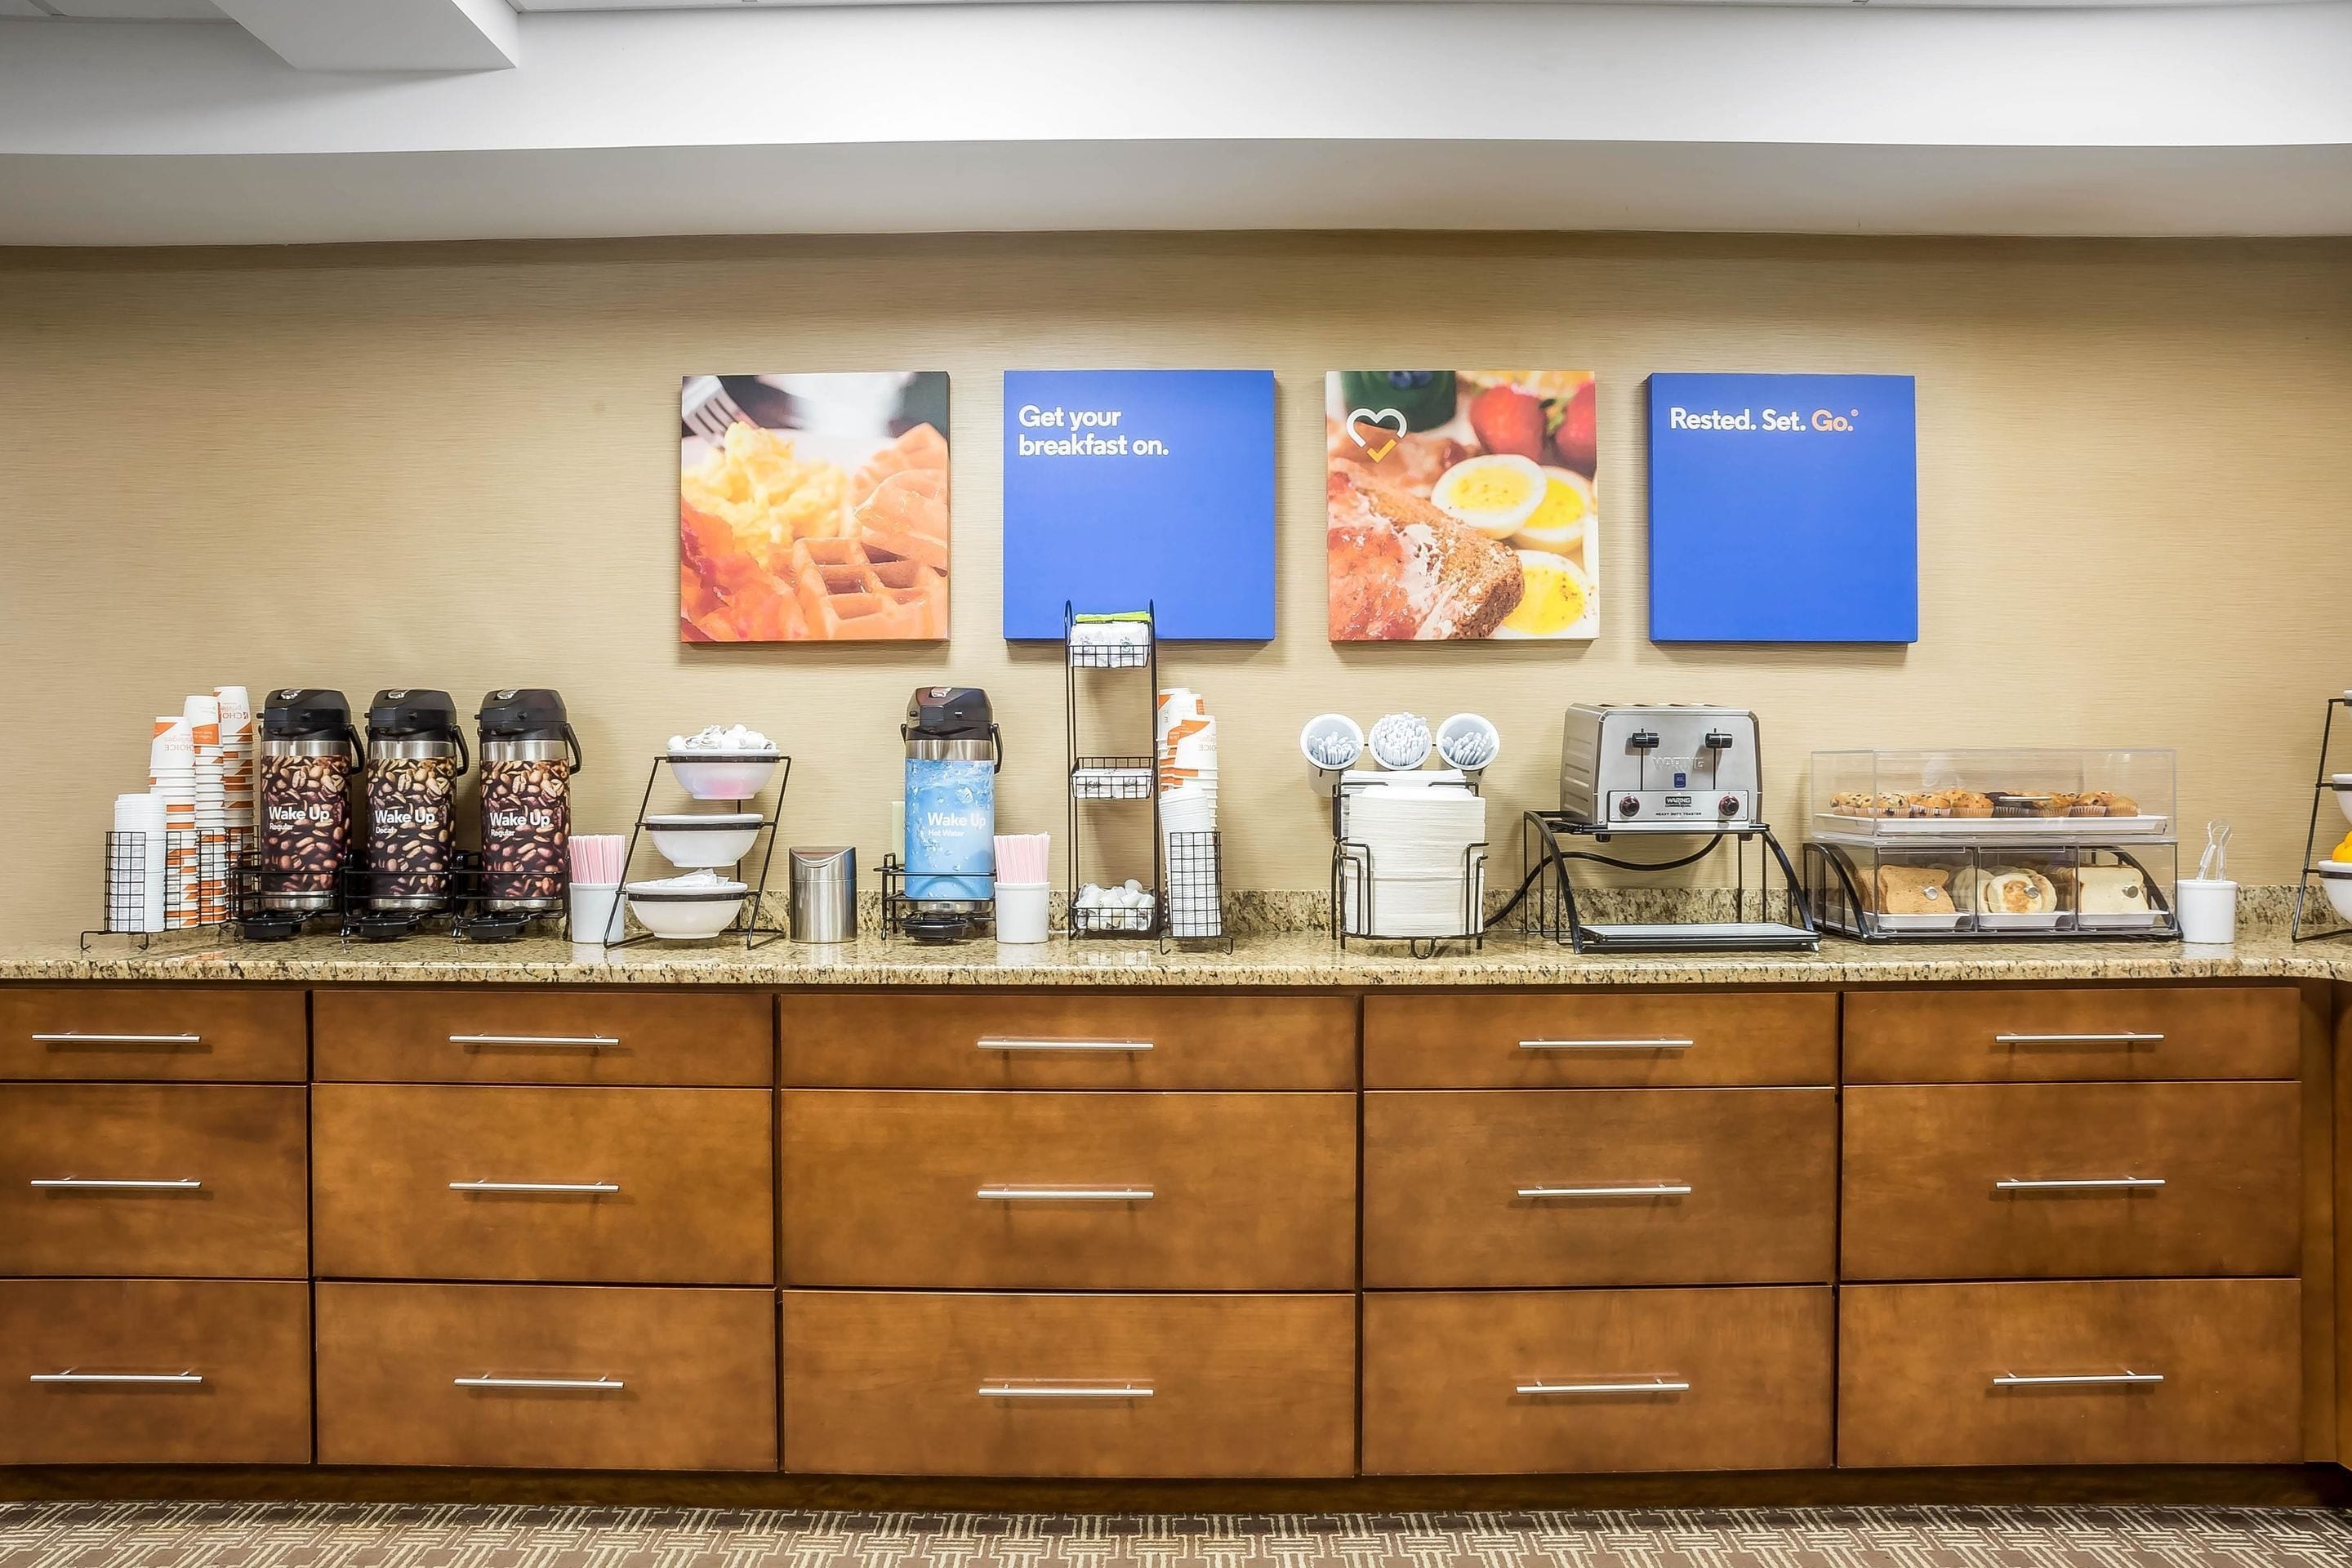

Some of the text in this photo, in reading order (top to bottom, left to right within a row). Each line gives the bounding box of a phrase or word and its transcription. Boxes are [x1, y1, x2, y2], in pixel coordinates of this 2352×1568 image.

[1018, 404, 1122, 432] Get your
[1670, 408, 1757, 431] Rested.
[1762, 408, 1806, 432] Set.
[1018, 432, 1169, 456] breakfast on.
[1198, 744, 1216, 752] OICE
[269, 806, 330, 822] Wake Up
[375, 809, 435, 826] Wake Up
[490, 812, 550, 828] Wake Up
[927, 812, 987, 830] Wake Up
[270, 822, 294, 831] Regular
[376, 826, 394, 834] Decaf
[491, 829, 515, 838] Regular
[928, 829, 965, 837] Hot Water
